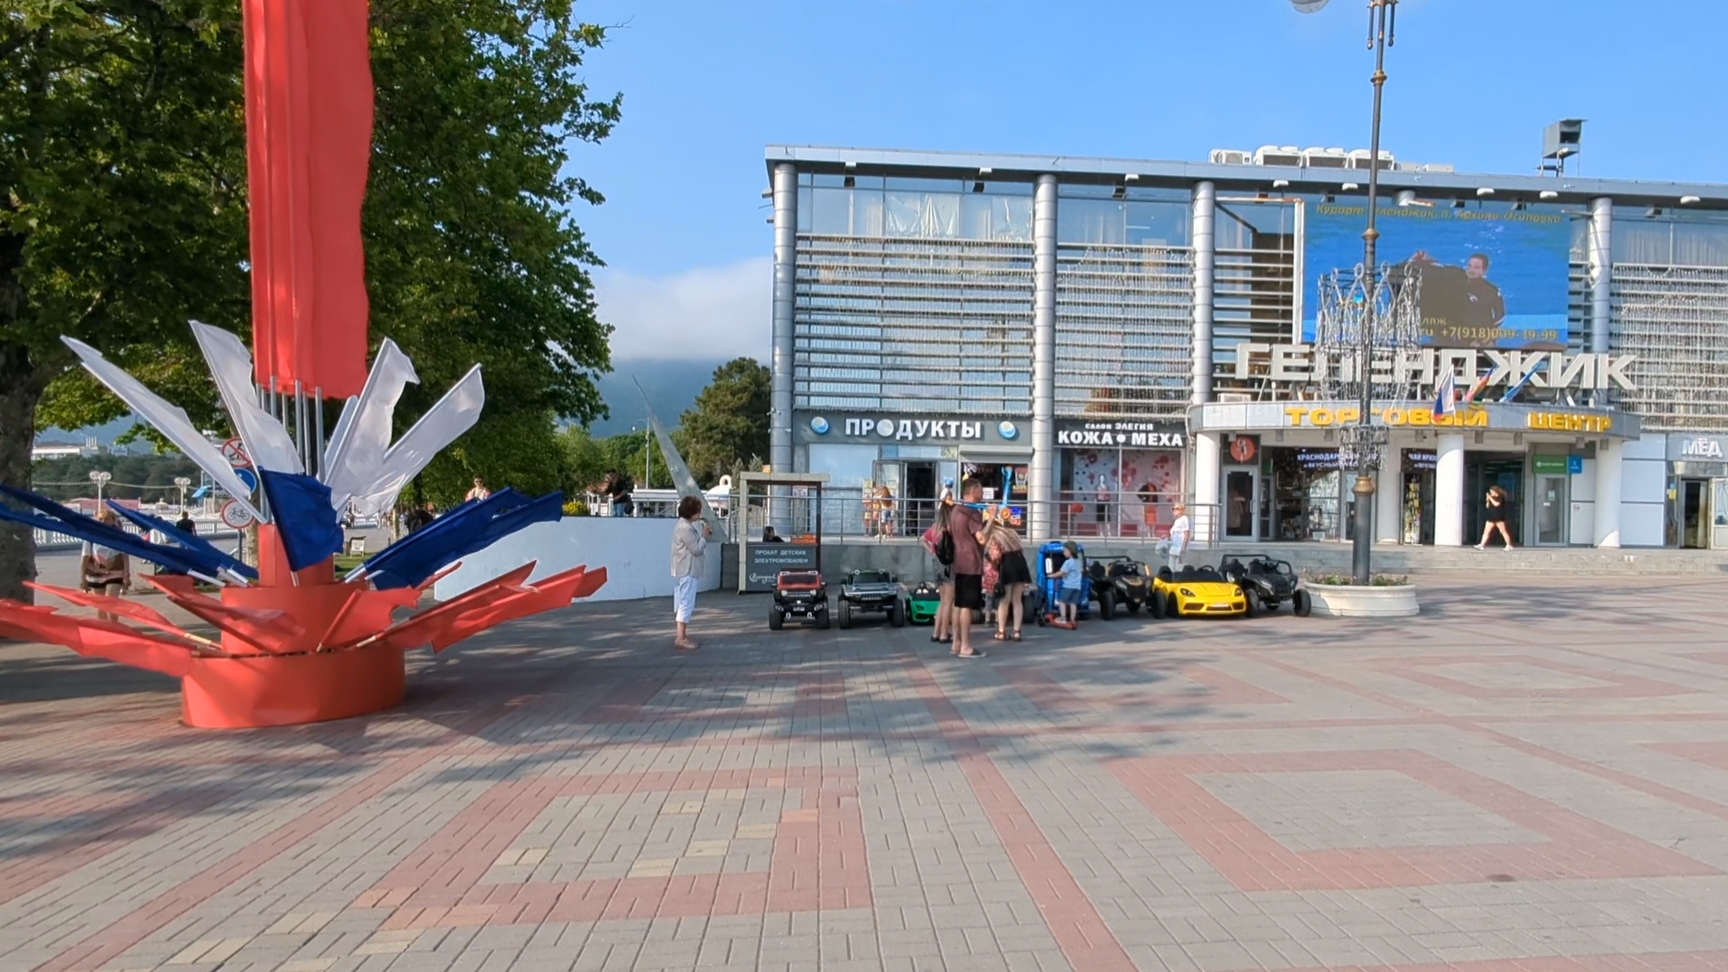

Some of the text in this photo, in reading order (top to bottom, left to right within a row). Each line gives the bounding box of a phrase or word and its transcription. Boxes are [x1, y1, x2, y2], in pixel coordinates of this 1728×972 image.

[1316, 203, 1364, 216] Курорт
[844, 417, 982, 440] ПРОДУКТЫ
[1114, 422, 1154, 431] ЭЛЕГИЯ
[1527, 410, 1612, 433] ЦЕНТР
[1057, 430, 1184, 447] КОЖА МЕХА
[1681, 436, 1724, 458] МЁД
